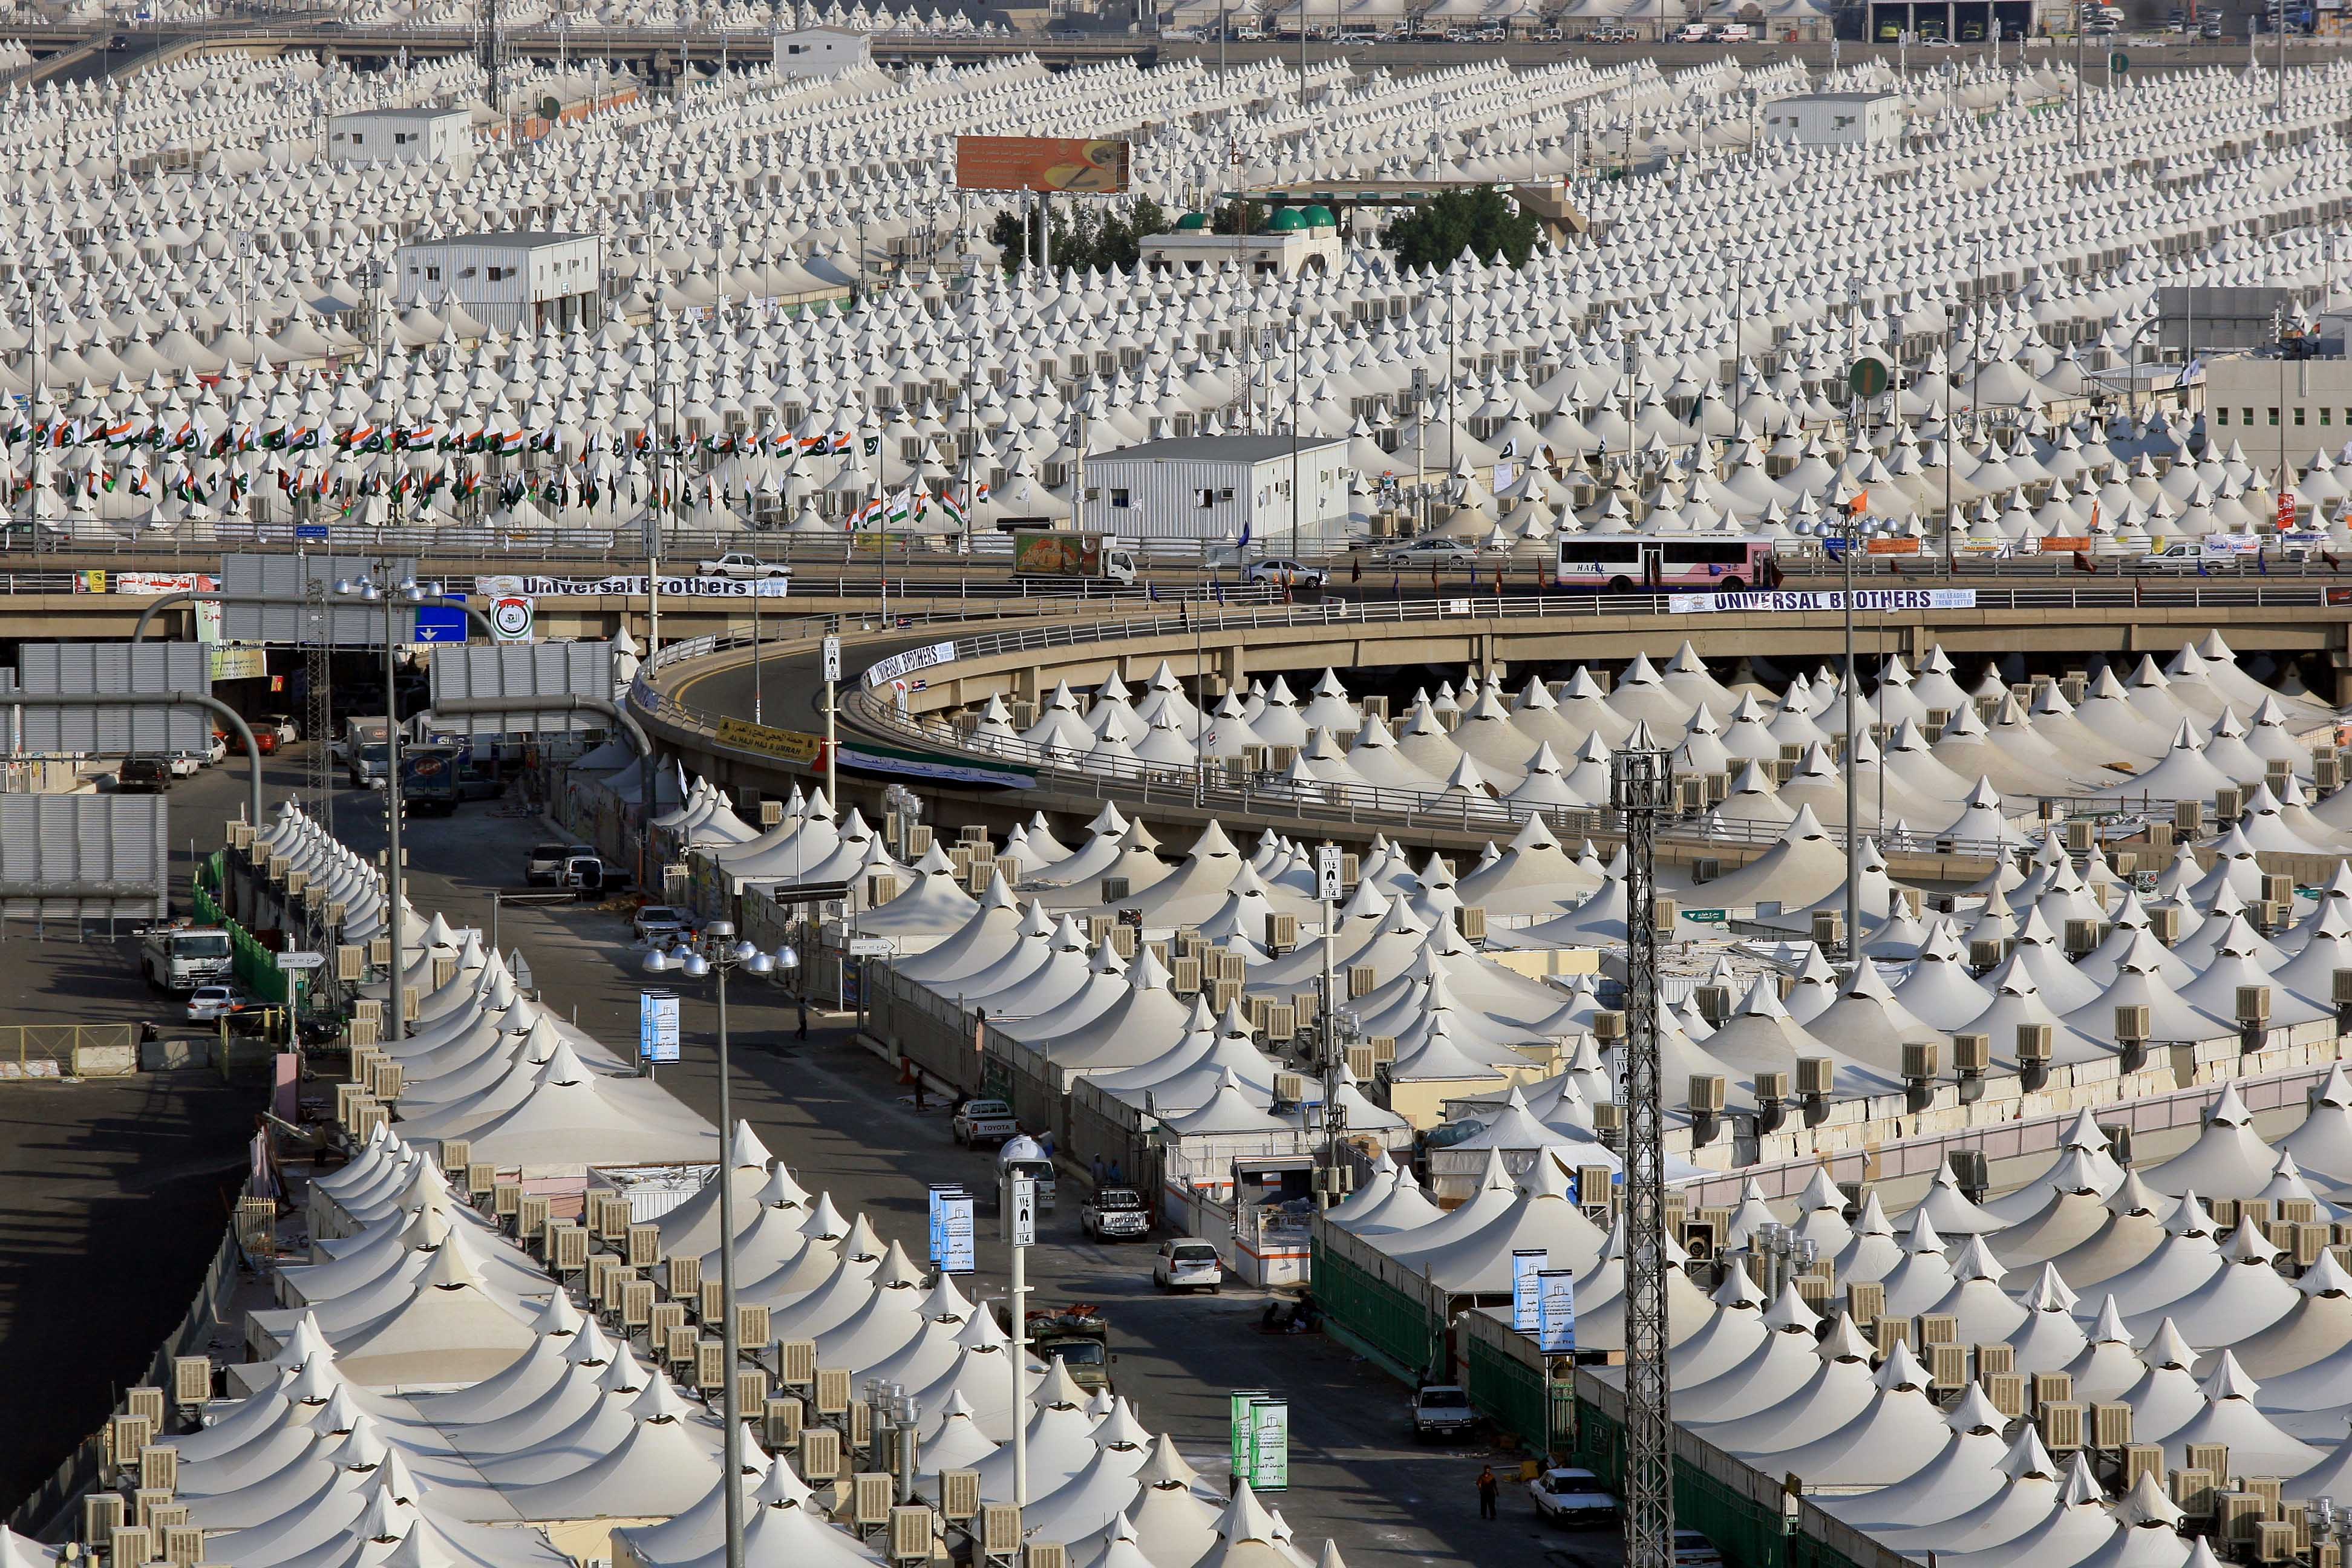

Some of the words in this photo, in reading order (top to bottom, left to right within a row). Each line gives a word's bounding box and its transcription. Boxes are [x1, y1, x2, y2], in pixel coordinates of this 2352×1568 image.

[1576, 564, 1606, 572] HAFL
[523, 577, 633, 594] Universal
[640, 578, 746, 595] Brothers
[1714, 592, 1822, 610] UNIVERSAL
[902, 645, 938, 671] BROTHERS
[775, 745, 802, 756] UMRAH
[1324, 860, 1336, 869] ١١٤
[1019, 1197, 1030, 1207] ١١٤
[1019, 1234, 1030, 1244] 114
